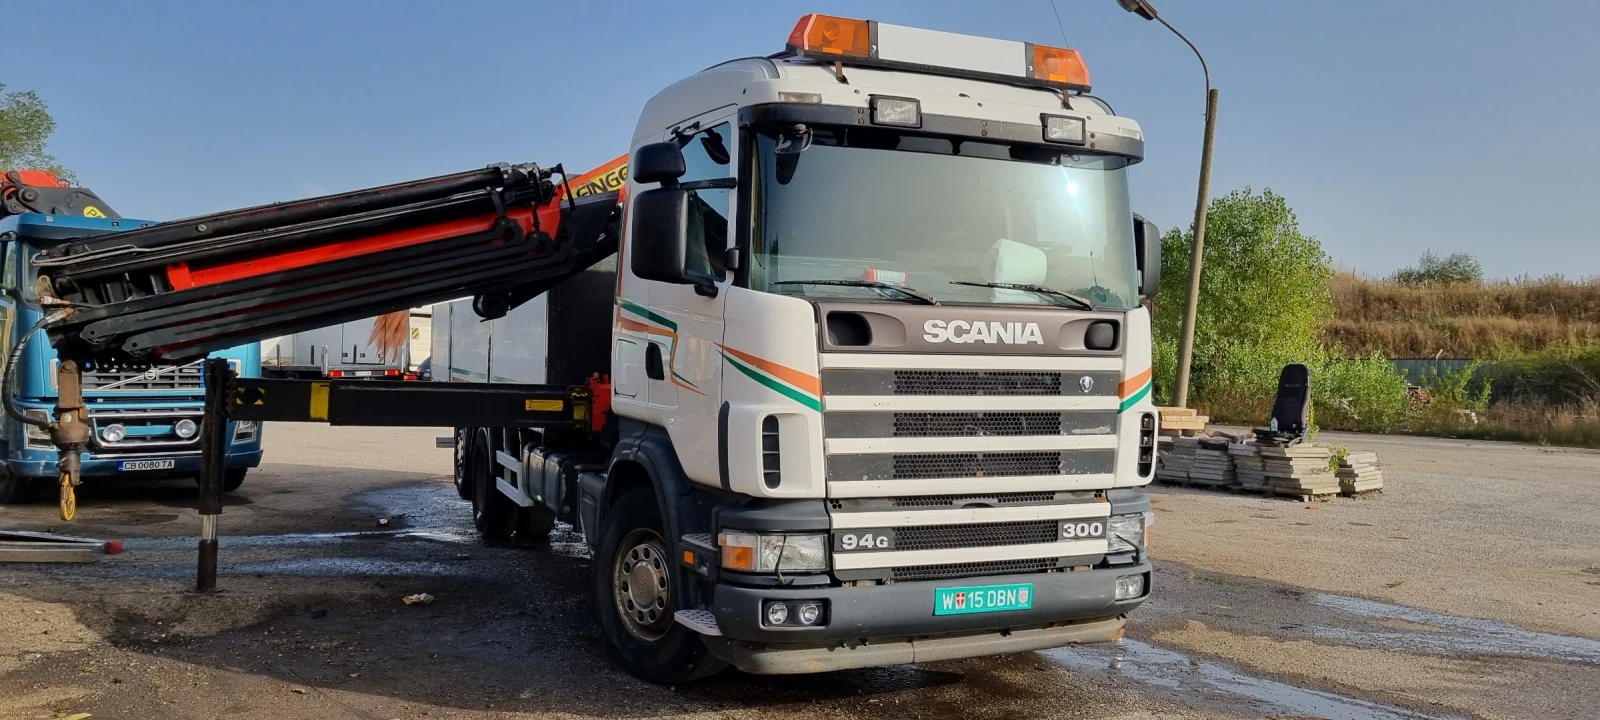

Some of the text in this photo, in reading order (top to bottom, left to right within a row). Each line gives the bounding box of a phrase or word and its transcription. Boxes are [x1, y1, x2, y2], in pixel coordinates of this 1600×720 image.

[922, 319, 1044, 345] SCANIA
[124, 460, 173, 470] CB 0080 TA
[1062, 522, 1103, 538] 300
[942, 593, 954, 610] W
[968, 591, 984, 609] 15
[987, 589, 1017, 607] DBN
